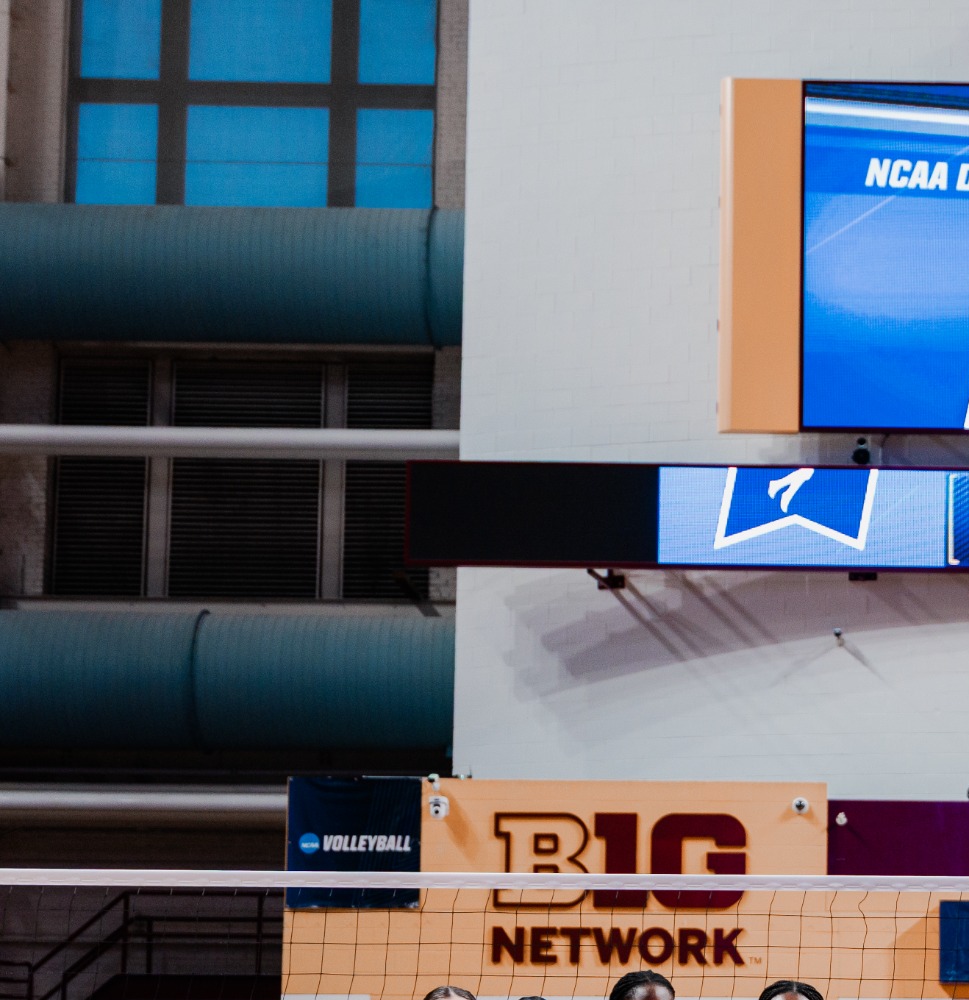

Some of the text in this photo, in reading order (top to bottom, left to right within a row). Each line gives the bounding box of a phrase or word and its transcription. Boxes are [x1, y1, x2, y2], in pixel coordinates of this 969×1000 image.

[865, 157, 948, 191] NCAA
[322, 834, 411, 852] VOLLEYBALL
[491, 926, 745, 965] NETWORK
